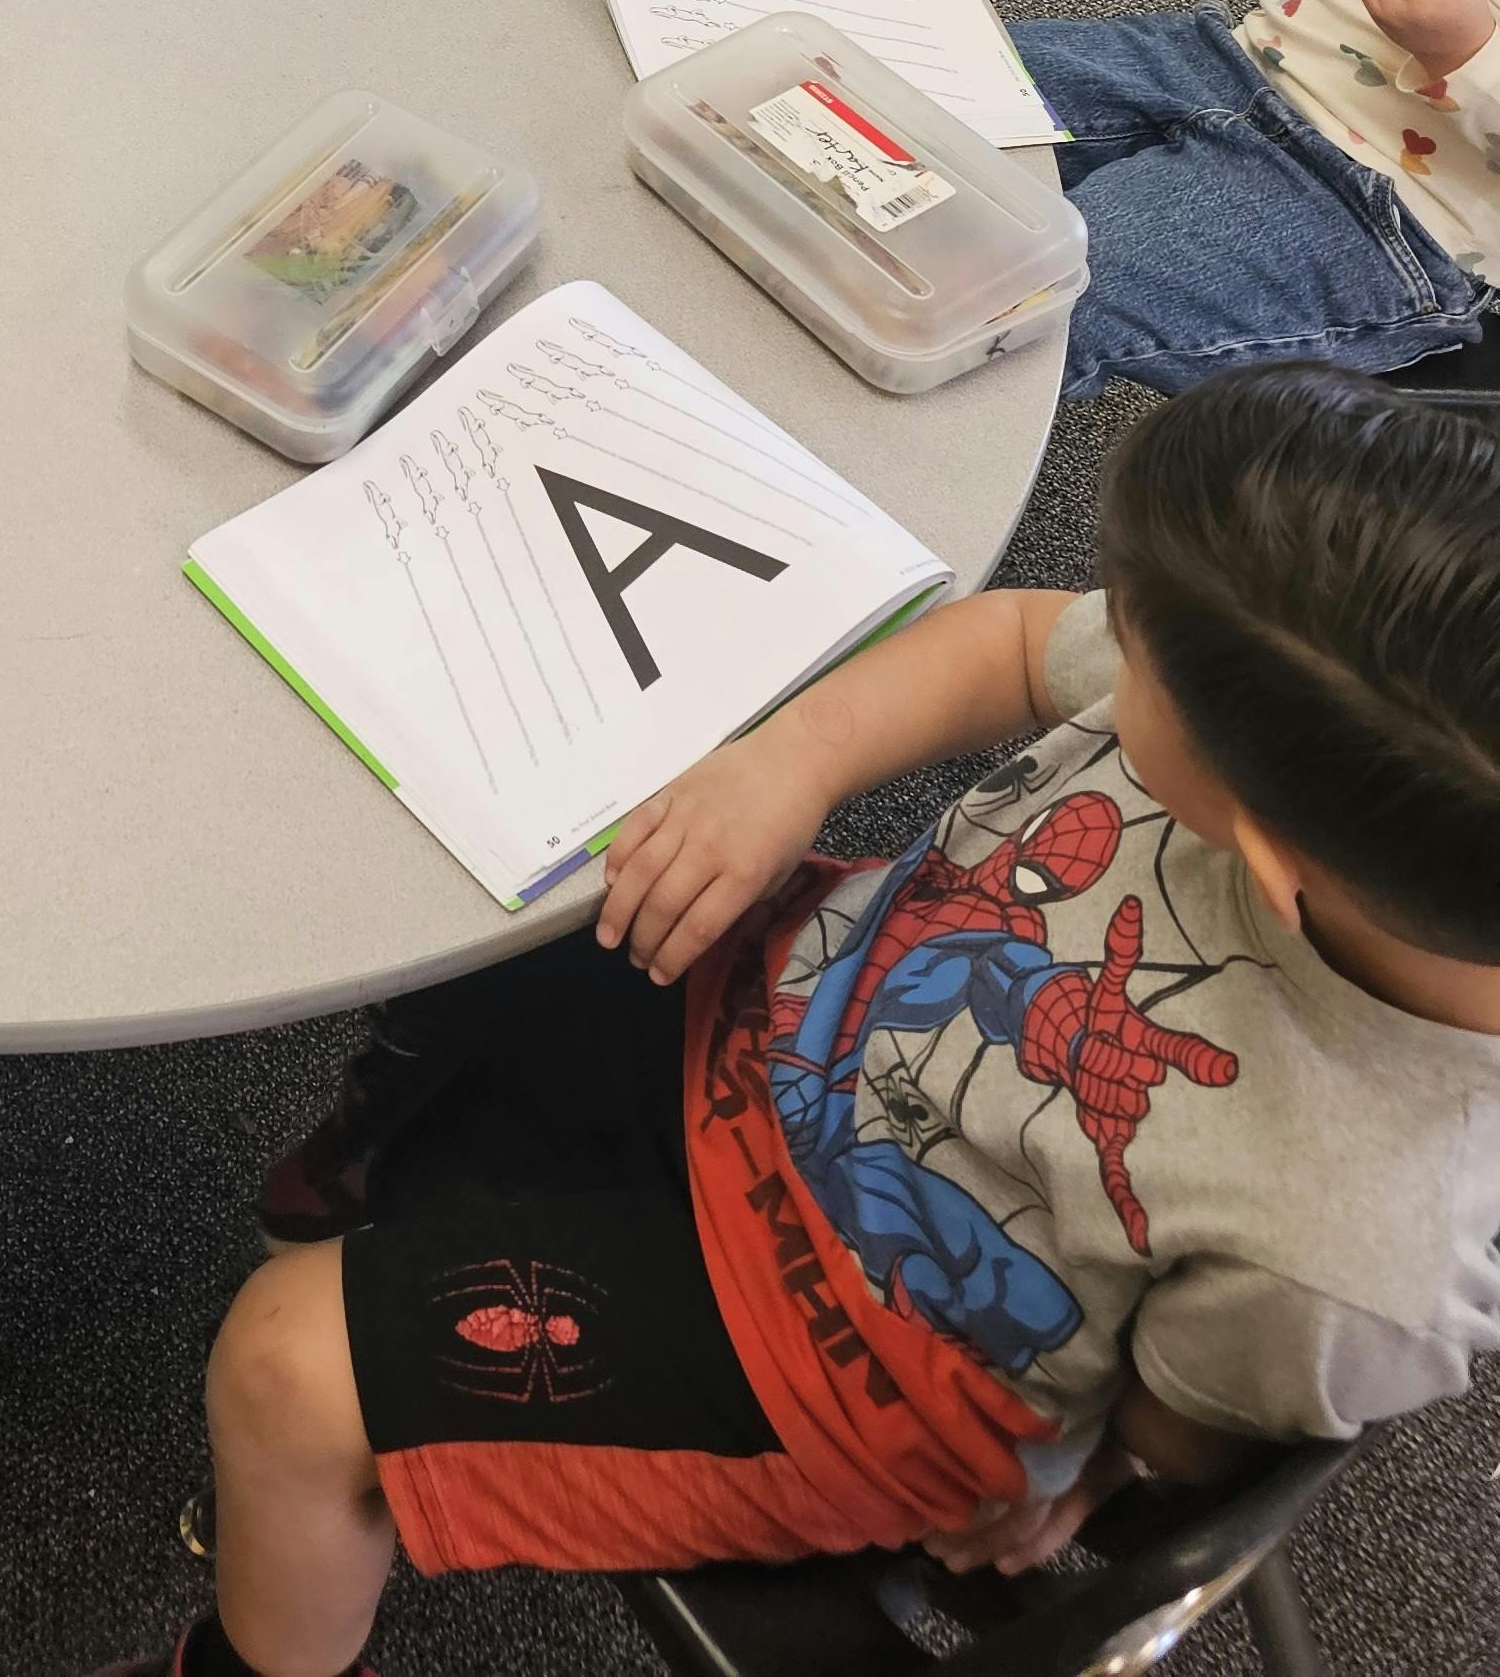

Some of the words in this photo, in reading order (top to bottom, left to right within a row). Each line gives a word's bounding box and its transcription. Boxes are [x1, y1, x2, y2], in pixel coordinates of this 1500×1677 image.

[805, 127, 869, 174] Karter
[827, 156, 844, 171] Box
[843, 170, 870, 192] Pencil
[534, 463, 791, 693] A
[546, 836, 561, 849] 50
